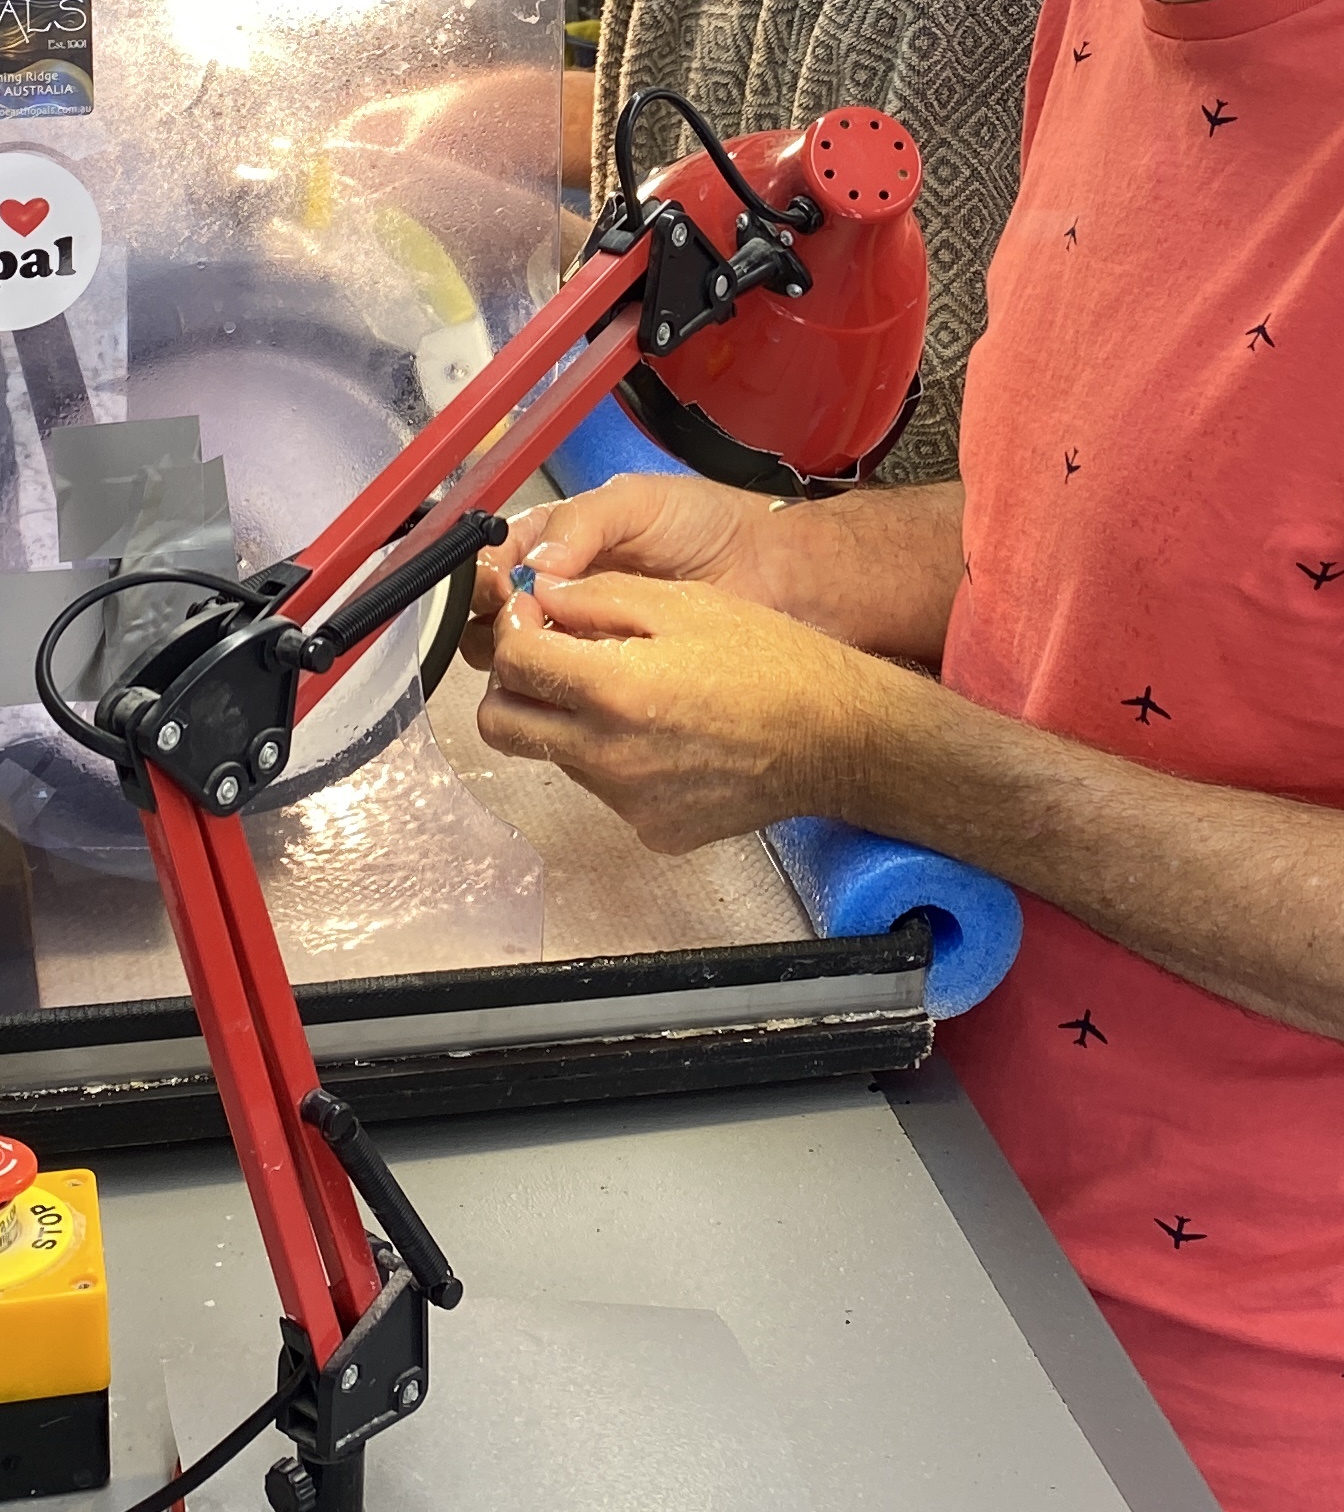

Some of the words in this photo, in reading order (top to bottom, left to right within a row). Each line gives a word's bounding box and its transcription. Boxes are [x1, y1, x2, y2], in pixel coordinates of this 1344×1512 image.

[26, 71, 59, 84] Ridge
[3, 84, 74, 97] AUSTRALIA
[30, 1204, 63, 1250] STOP
